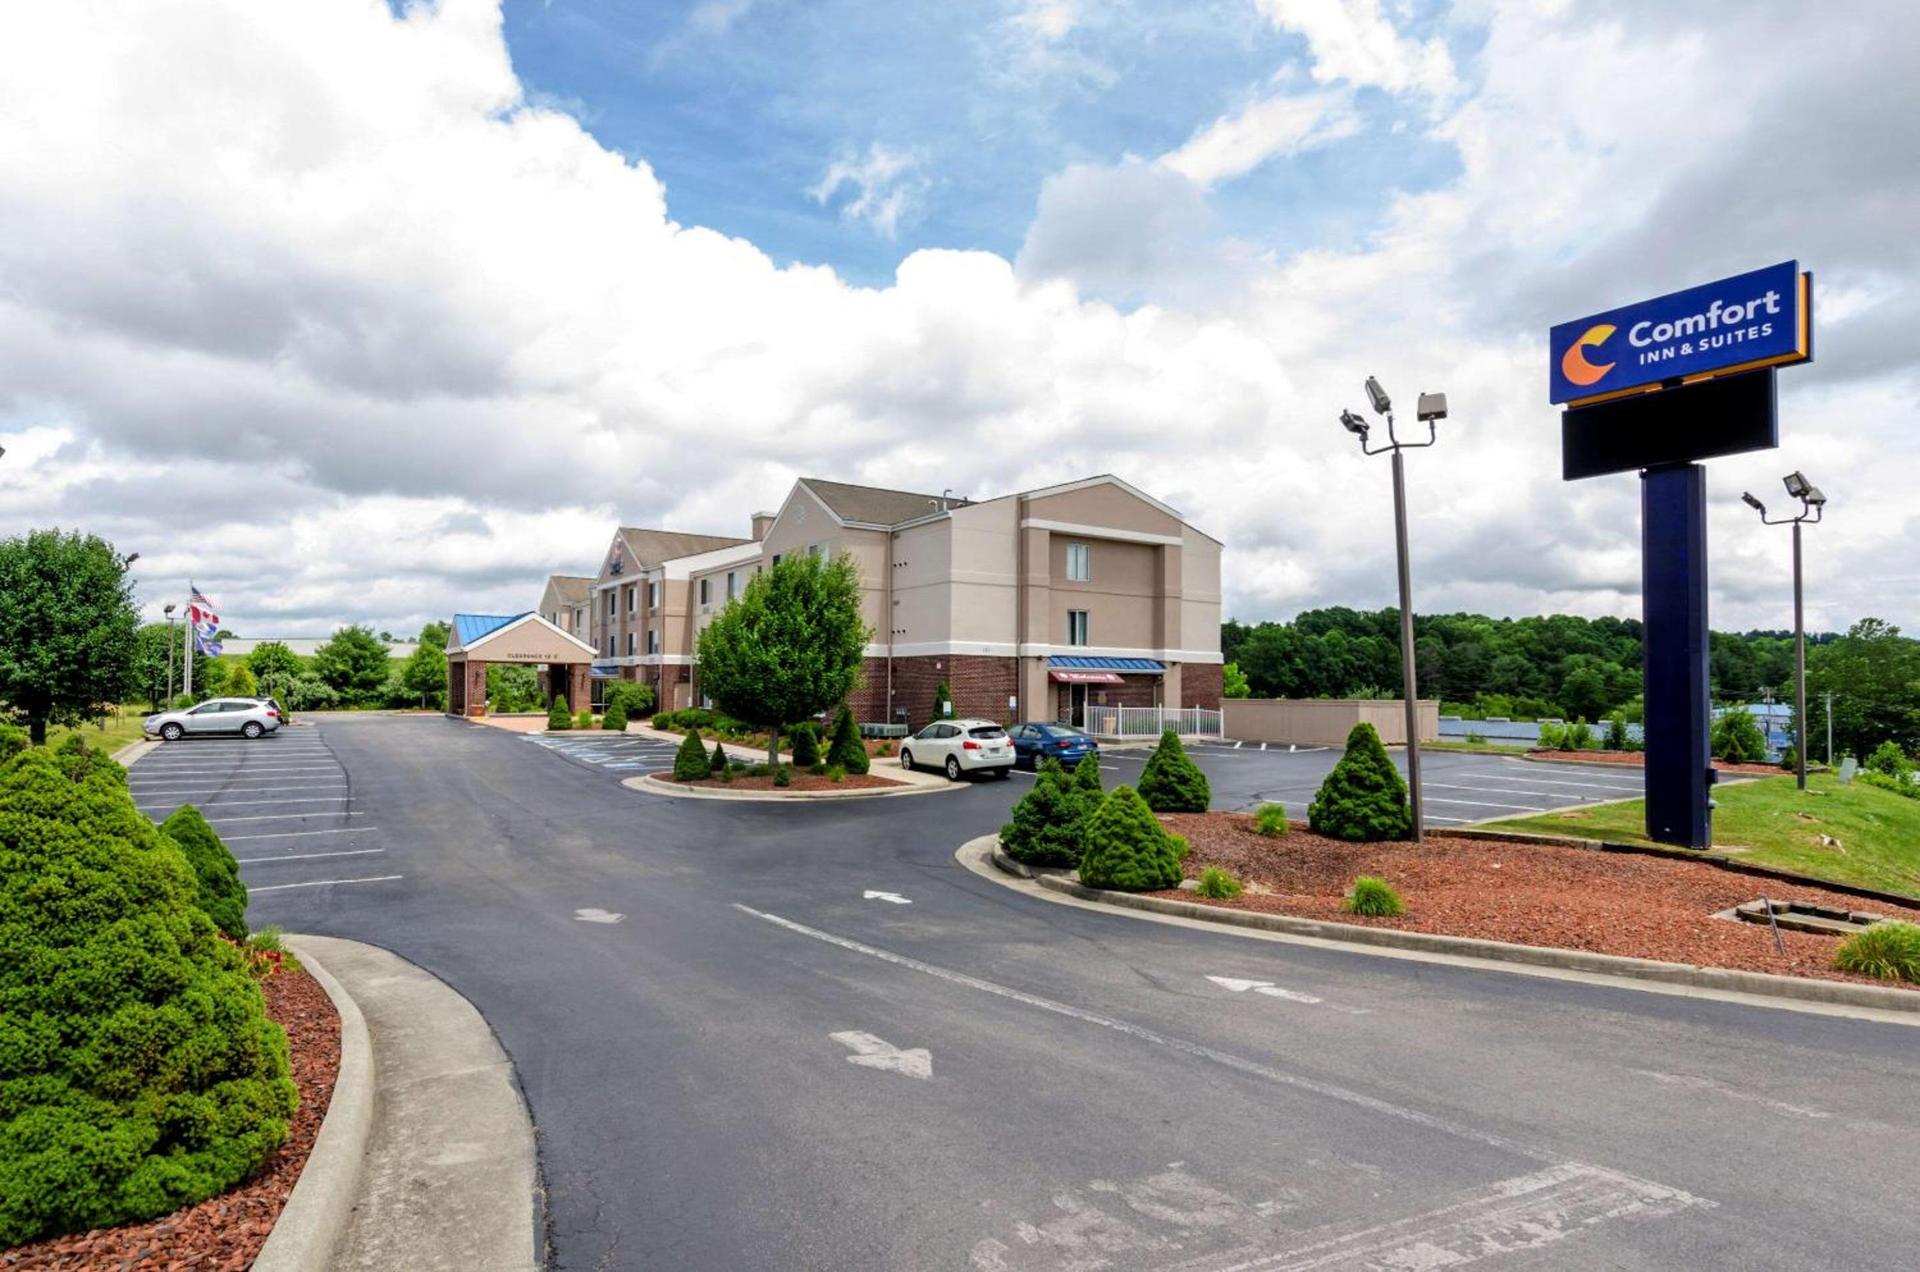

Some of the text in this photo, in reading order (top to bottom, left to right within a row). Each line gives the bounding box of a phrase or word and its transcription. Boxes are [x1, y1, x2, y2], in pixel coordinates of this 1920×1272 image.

[1628, 289, 1781, 348] Comfort
[1639, 322, 1773, 365] INN & SUITES
